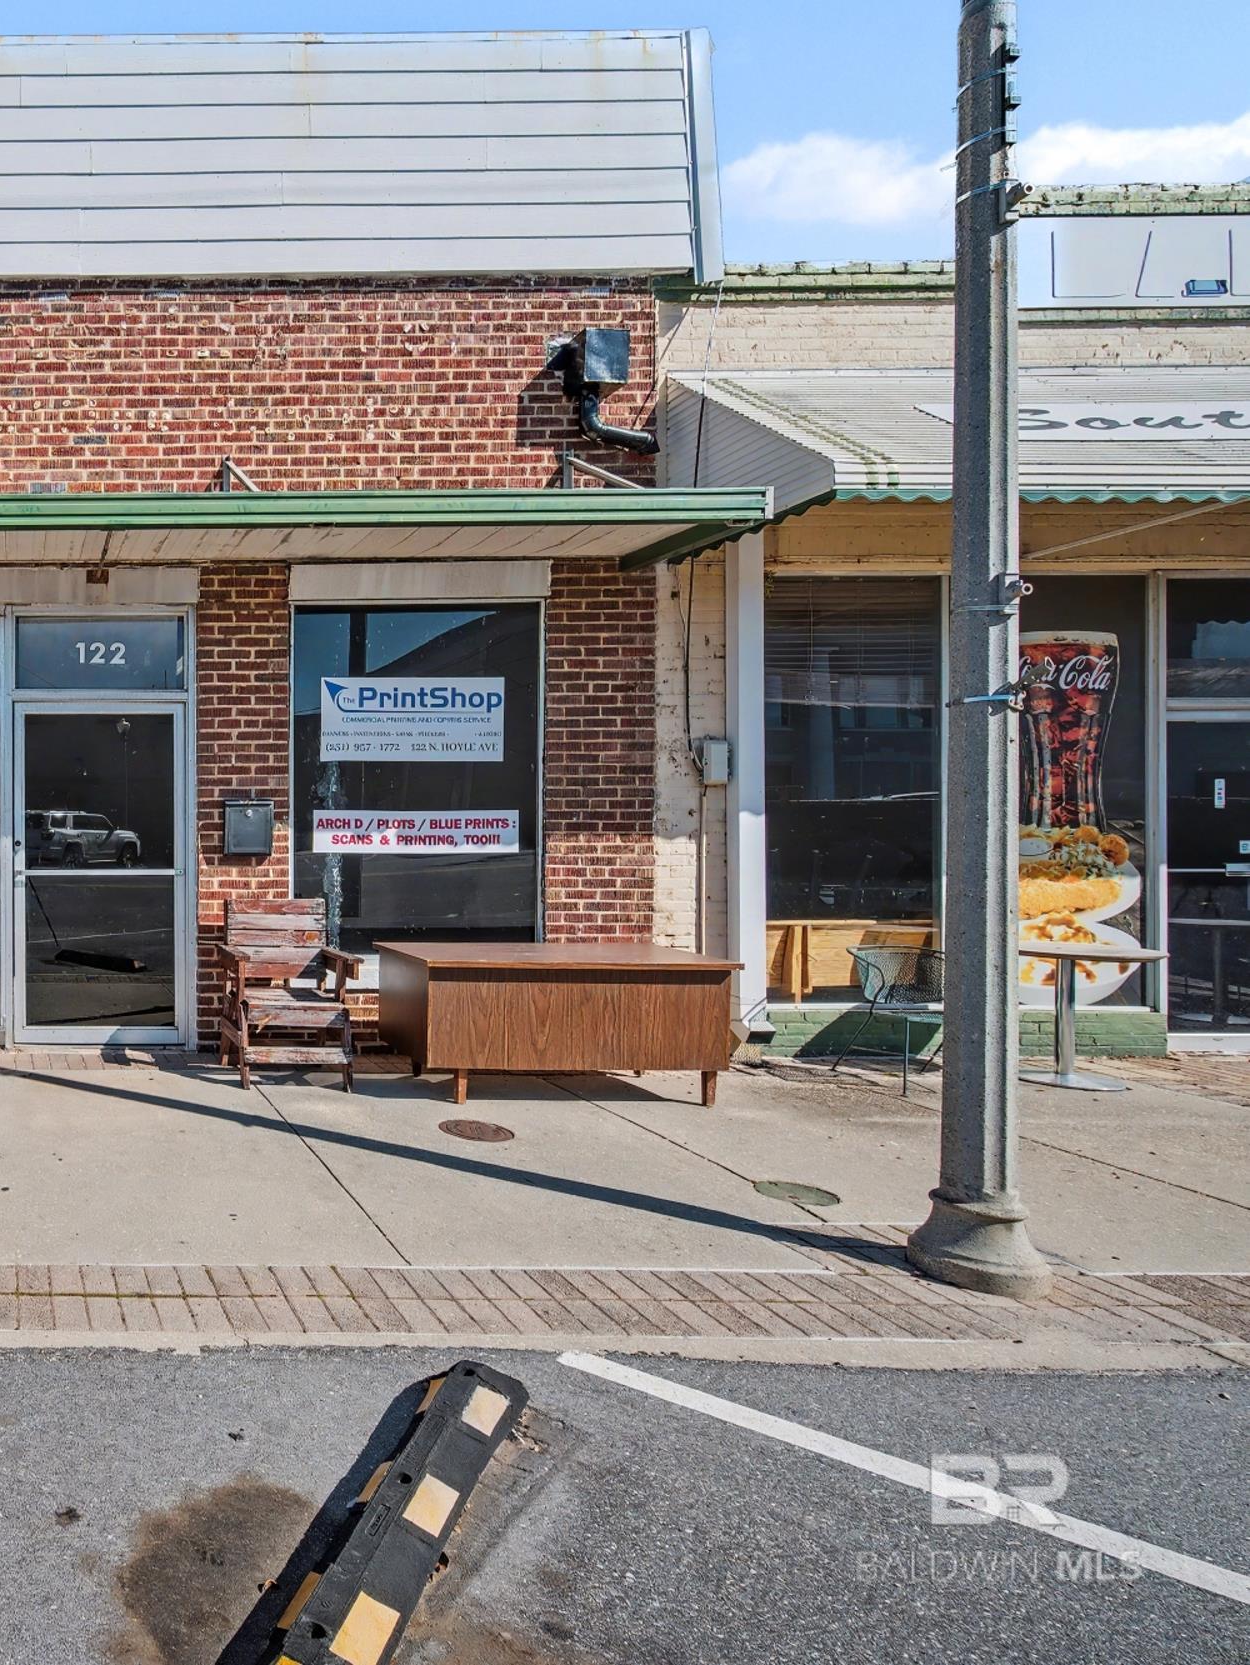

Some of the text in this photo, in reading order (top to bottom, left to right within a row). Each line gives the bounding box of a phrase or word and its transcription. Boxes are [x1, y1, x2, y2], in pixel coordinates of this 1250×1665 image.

[75, 642, 126, 665] 122
[358, 687, 502, 713] PrintShop
[441, 743, 477, 752] HOYLE
[478, 743, 499, 752] AVE
[316, 818, 352, 830] ARCH
[354, 818, 363, 829] D
[377, 818, 416, 830] PLOTS
[429, 818, 462, 829] BLUE
[465, 818, 510, 829] PRINTS
[331, 834, 374, 845] SCANS
[379, 834, 390, 845] &
[396, 834, 458, 847] PRINTING,
